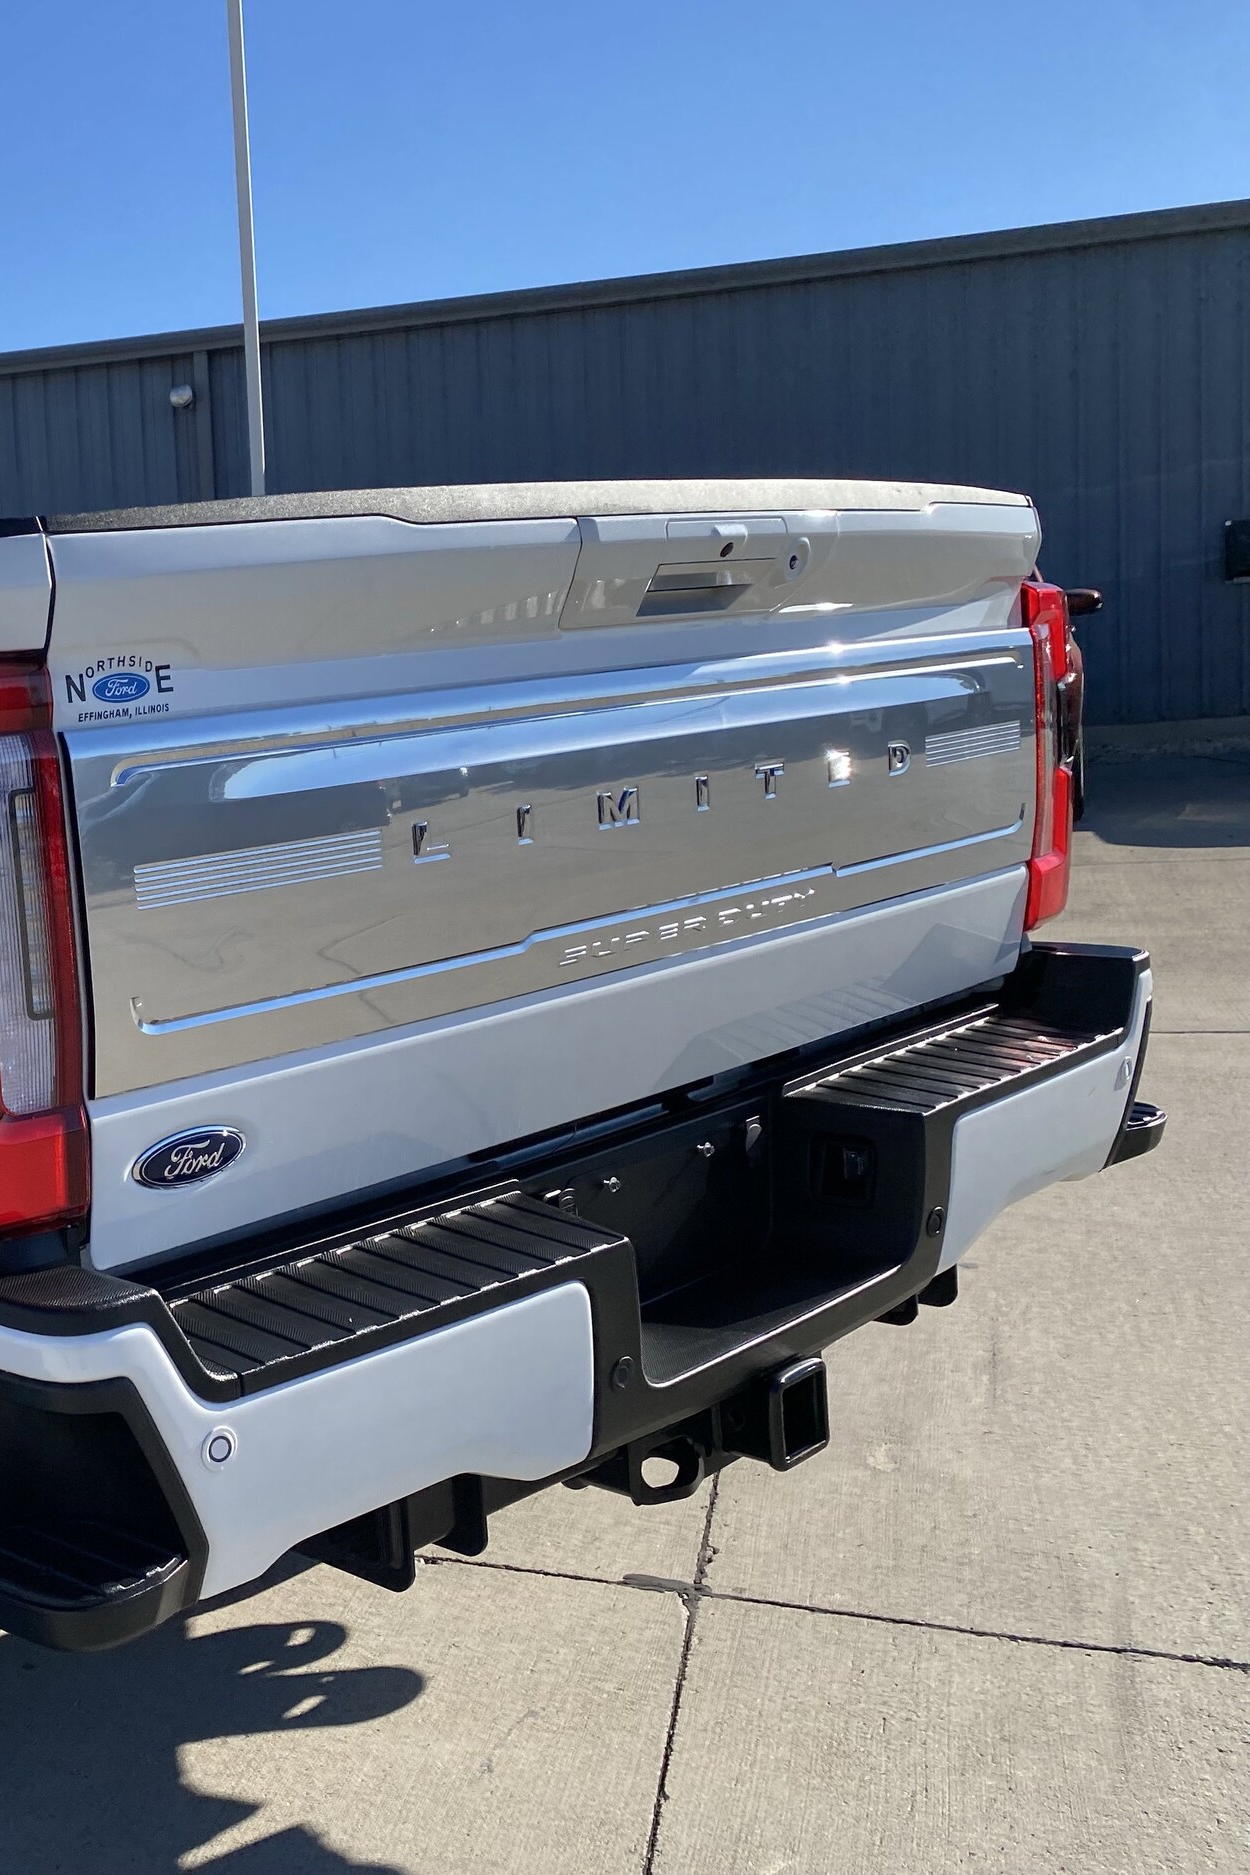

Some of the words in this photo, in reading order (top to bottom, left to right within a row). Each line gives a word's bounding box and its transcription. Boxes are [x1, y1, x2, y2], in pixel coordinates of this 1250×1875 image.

[65, 656, 174, 703] NORTHSIDE
[105, 678, 138, 697] Ford
[78, 707, 132, 722] EFFINGHAM,
[135, 703, 169, 716] ILLINOIS
[411, 740, 911, 864] LIMITED
[559, 916, 707, 967] SUPER
[164, 1139, 225, 1178] Ford
